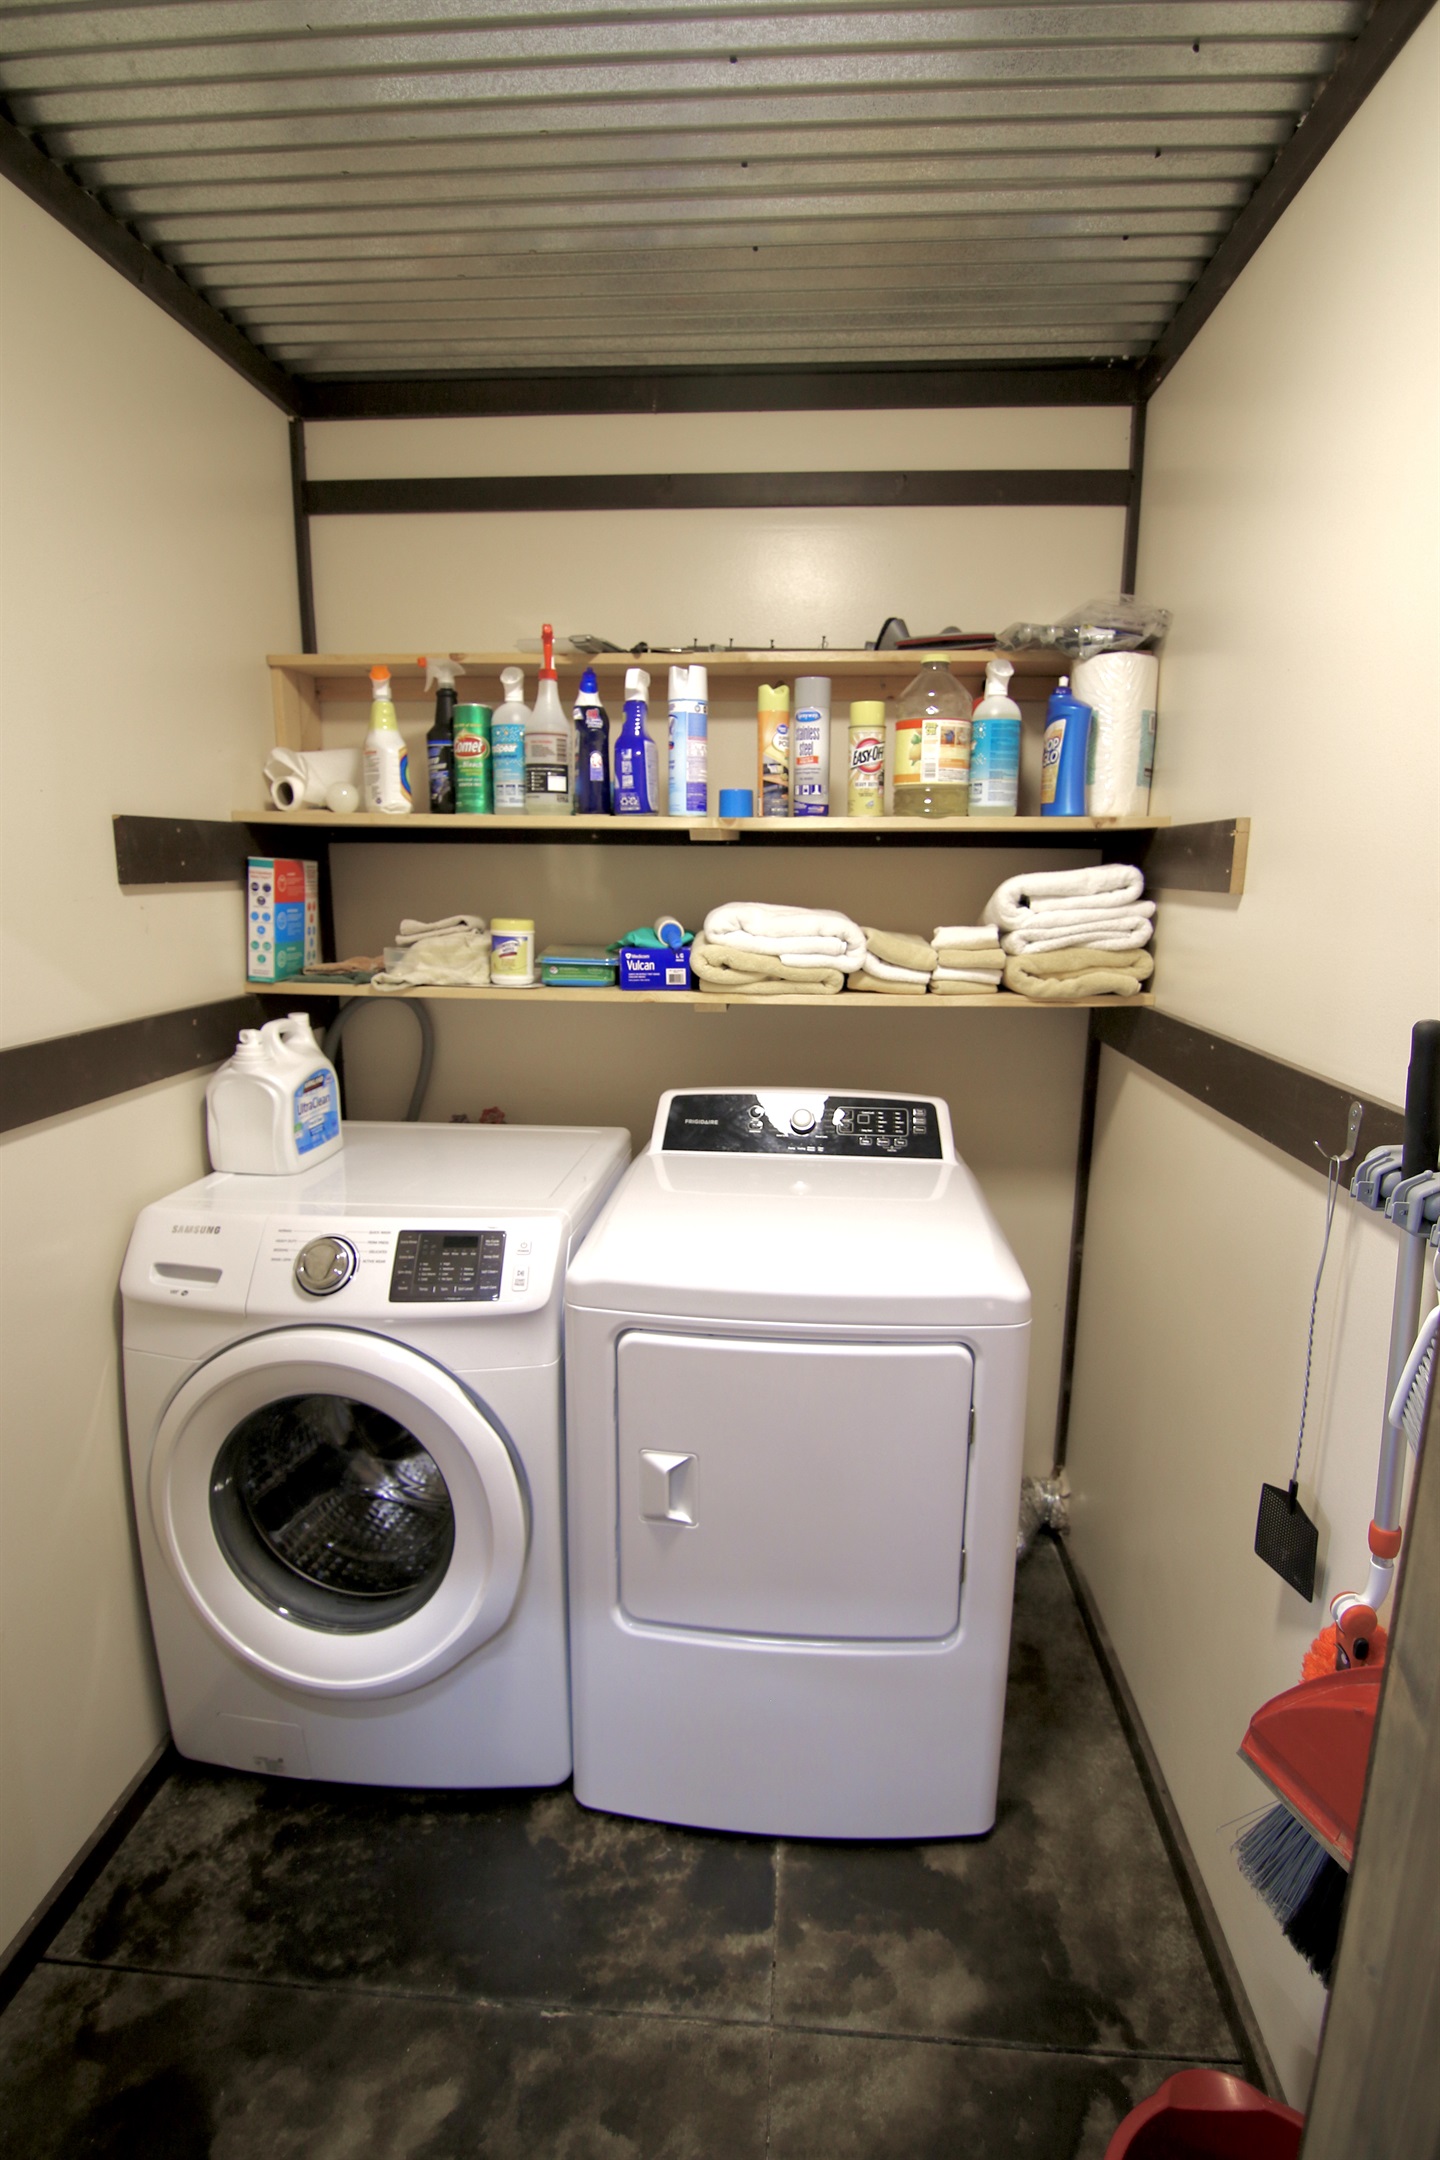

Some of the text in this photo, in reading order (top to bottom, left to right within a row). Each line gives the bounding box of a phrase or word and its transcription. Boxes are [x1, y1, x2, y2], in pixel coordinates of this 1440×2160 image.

[799, 741, 814, 756] steel
[626, 959, 655, 971] Vulcan
[297, 1094, 331, 1116] UltraClean
[171, 1224, 222, 1235] SAMSUNG
